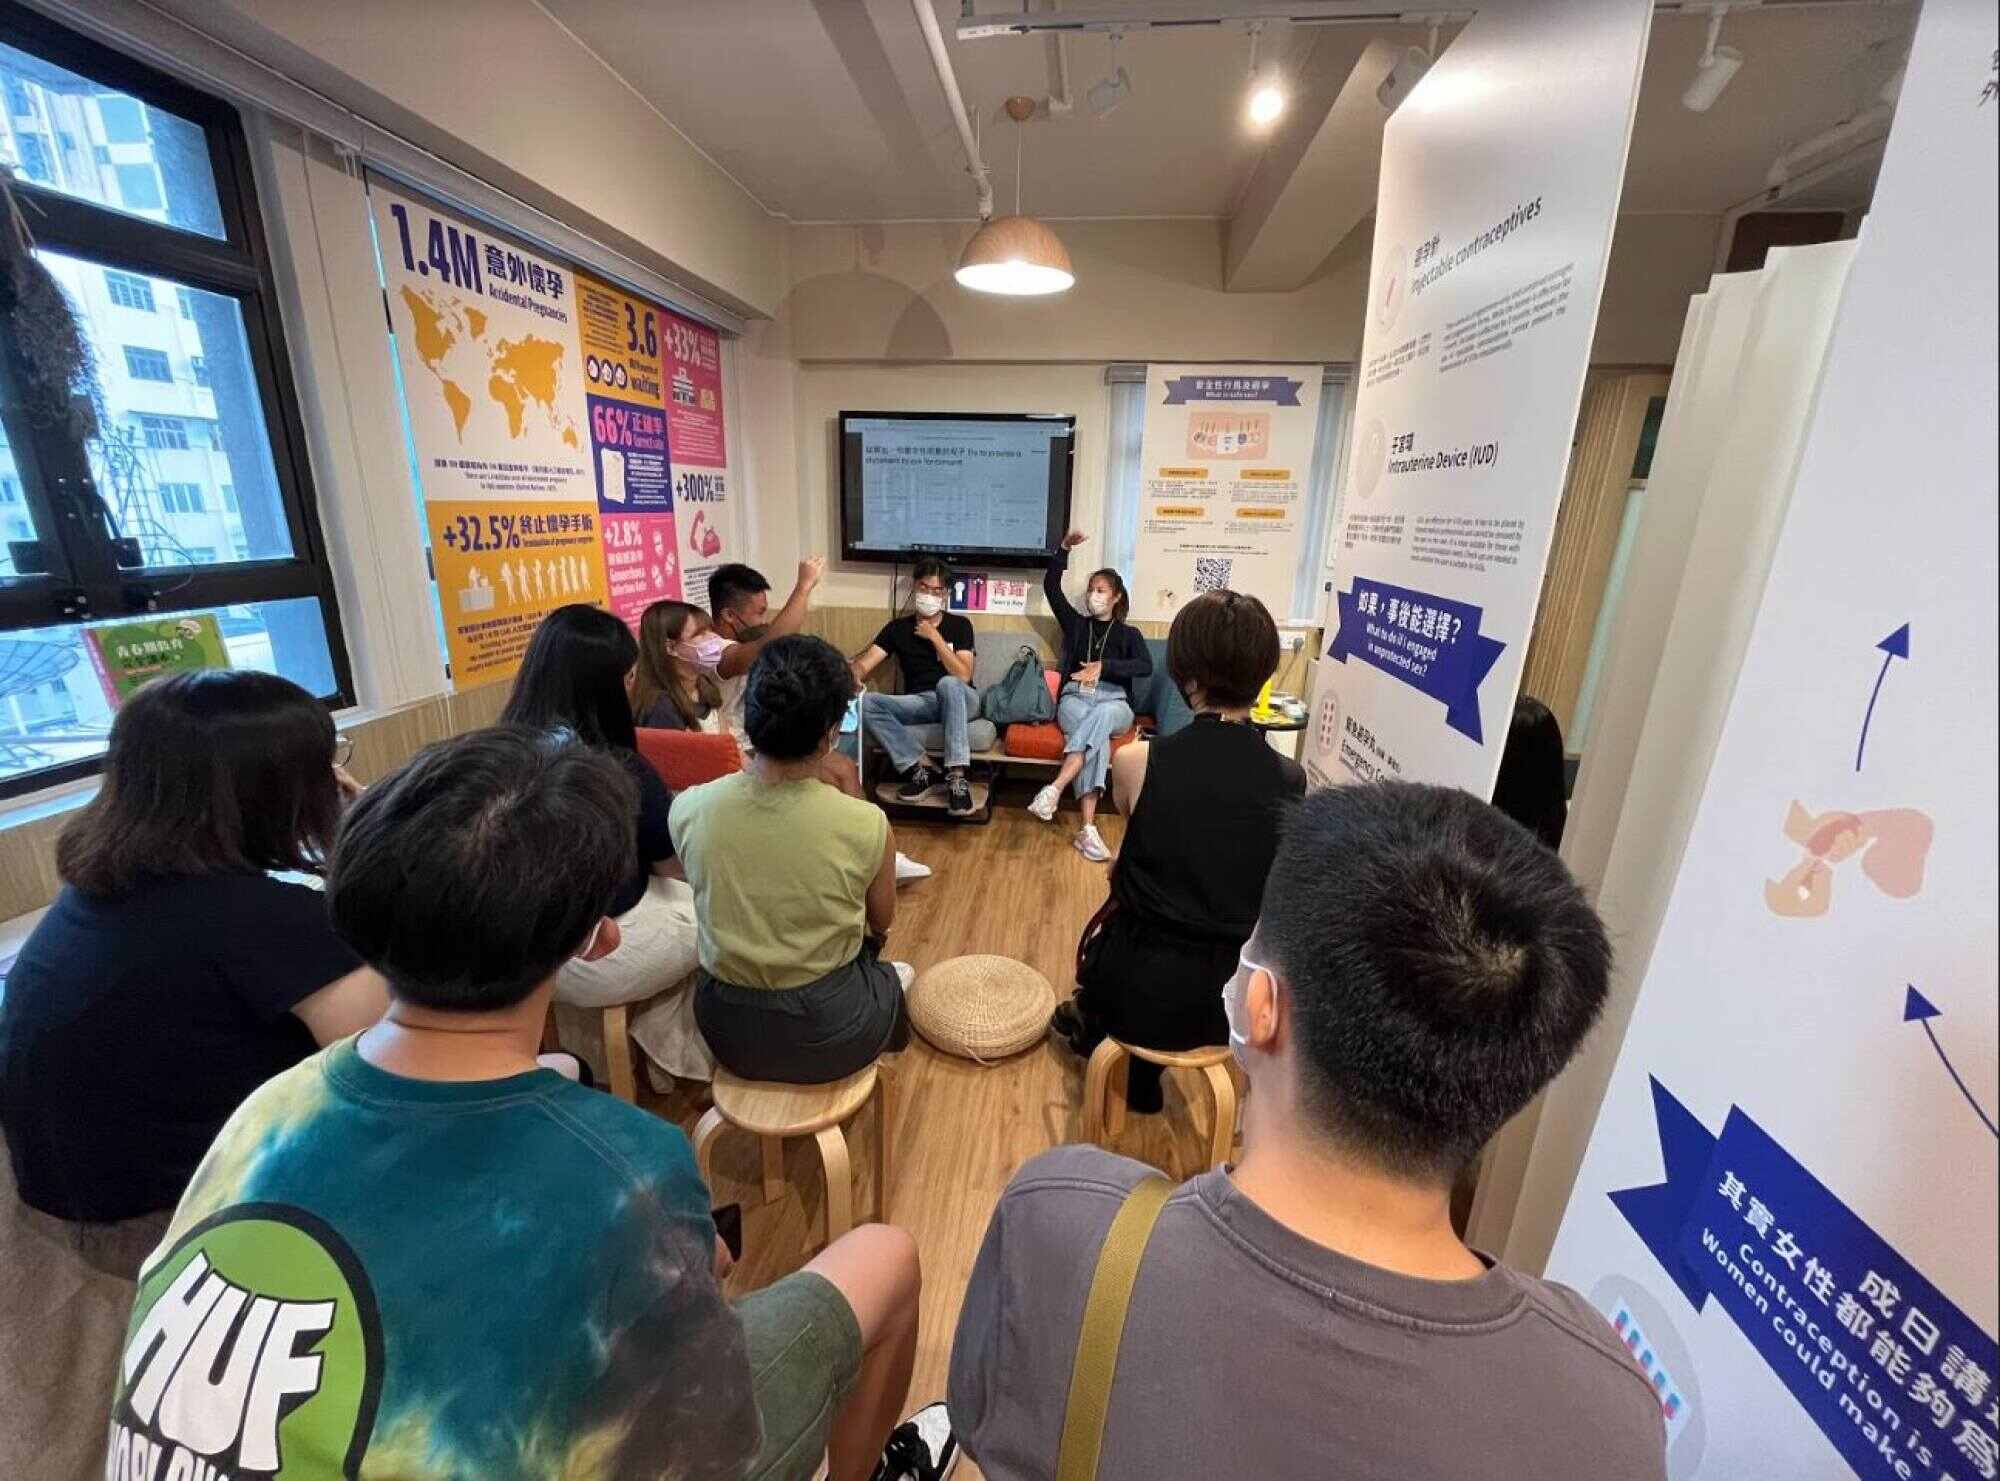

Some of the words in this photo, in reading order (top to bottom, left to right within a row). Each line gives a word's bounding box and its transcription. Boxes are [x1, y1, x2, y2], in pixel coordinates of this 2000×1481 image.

[391, 204, 483, 295] 1.4M
[1455, 196, 1542, 266] contraceptives
[485, 243, 564, 299] 意外懷孕
[624, 302, 657, 359] 3.6
[663, 322, 701, 367] +33%
[593, 405, 633, 446] 66%
[1436, 450, 1467, 470] Device
[1468, 441, 1499, 470] (IUD)
[676, 472, 714, 502] +300%
[443, 514, 520, 552] +32.5%
[1366, 623, 1380, 638] What
[1407, 639, 1438, 662] engaged
[123, 1249, 337, 1472] HUF
[1701, 1228, 1769, 1314] Women
[1773, 1316, 1836, 1390] could
[1839, 1393, 1913, 1481] make
[1740, 1243, 1901, 1430] Contraception
[1907, 1430, 1933, 1467] is
